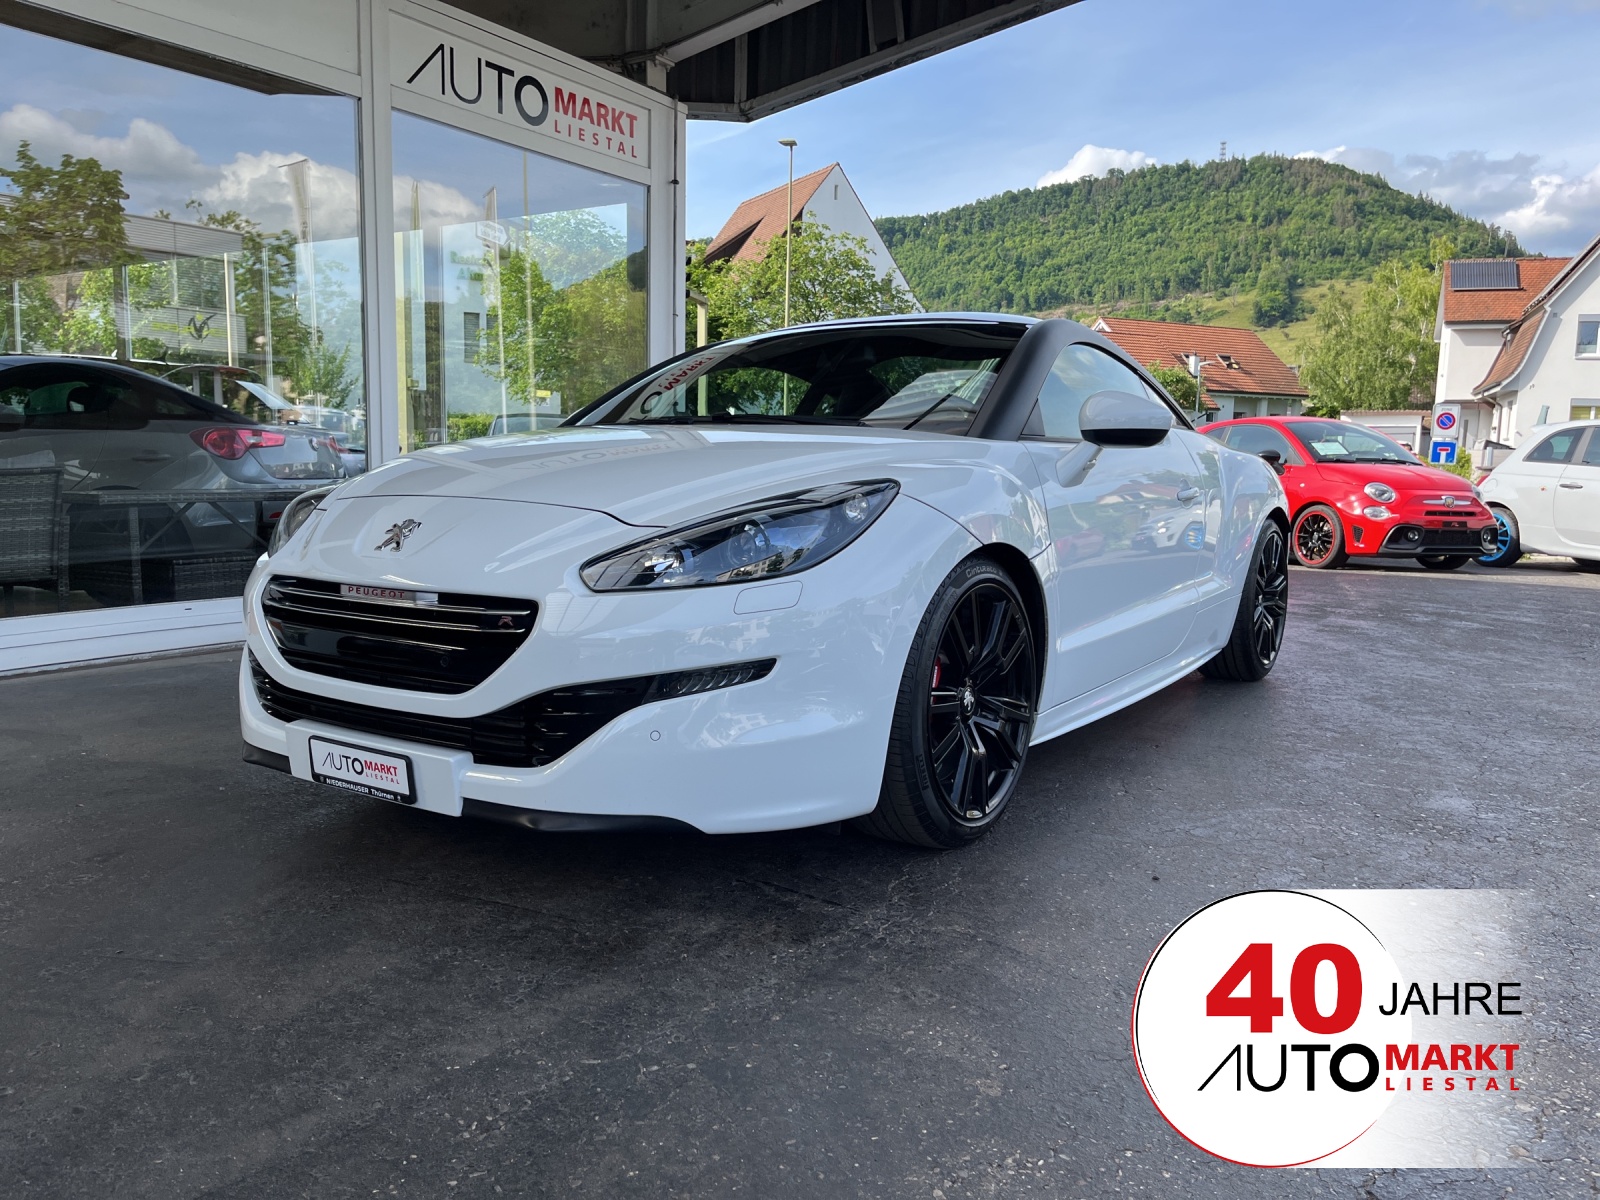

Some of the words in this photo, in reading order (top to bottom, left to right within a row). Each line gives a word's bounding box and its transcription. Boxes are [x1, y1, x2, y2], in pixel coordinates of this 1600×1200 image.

[554, 119, 638, 158] LIESTAL
[347, 585, 405, 599] PEUGEOT
[326, 778, 369, 794] NIEDERHAUSER
[365, 772, 400, 785] LIESTAL
